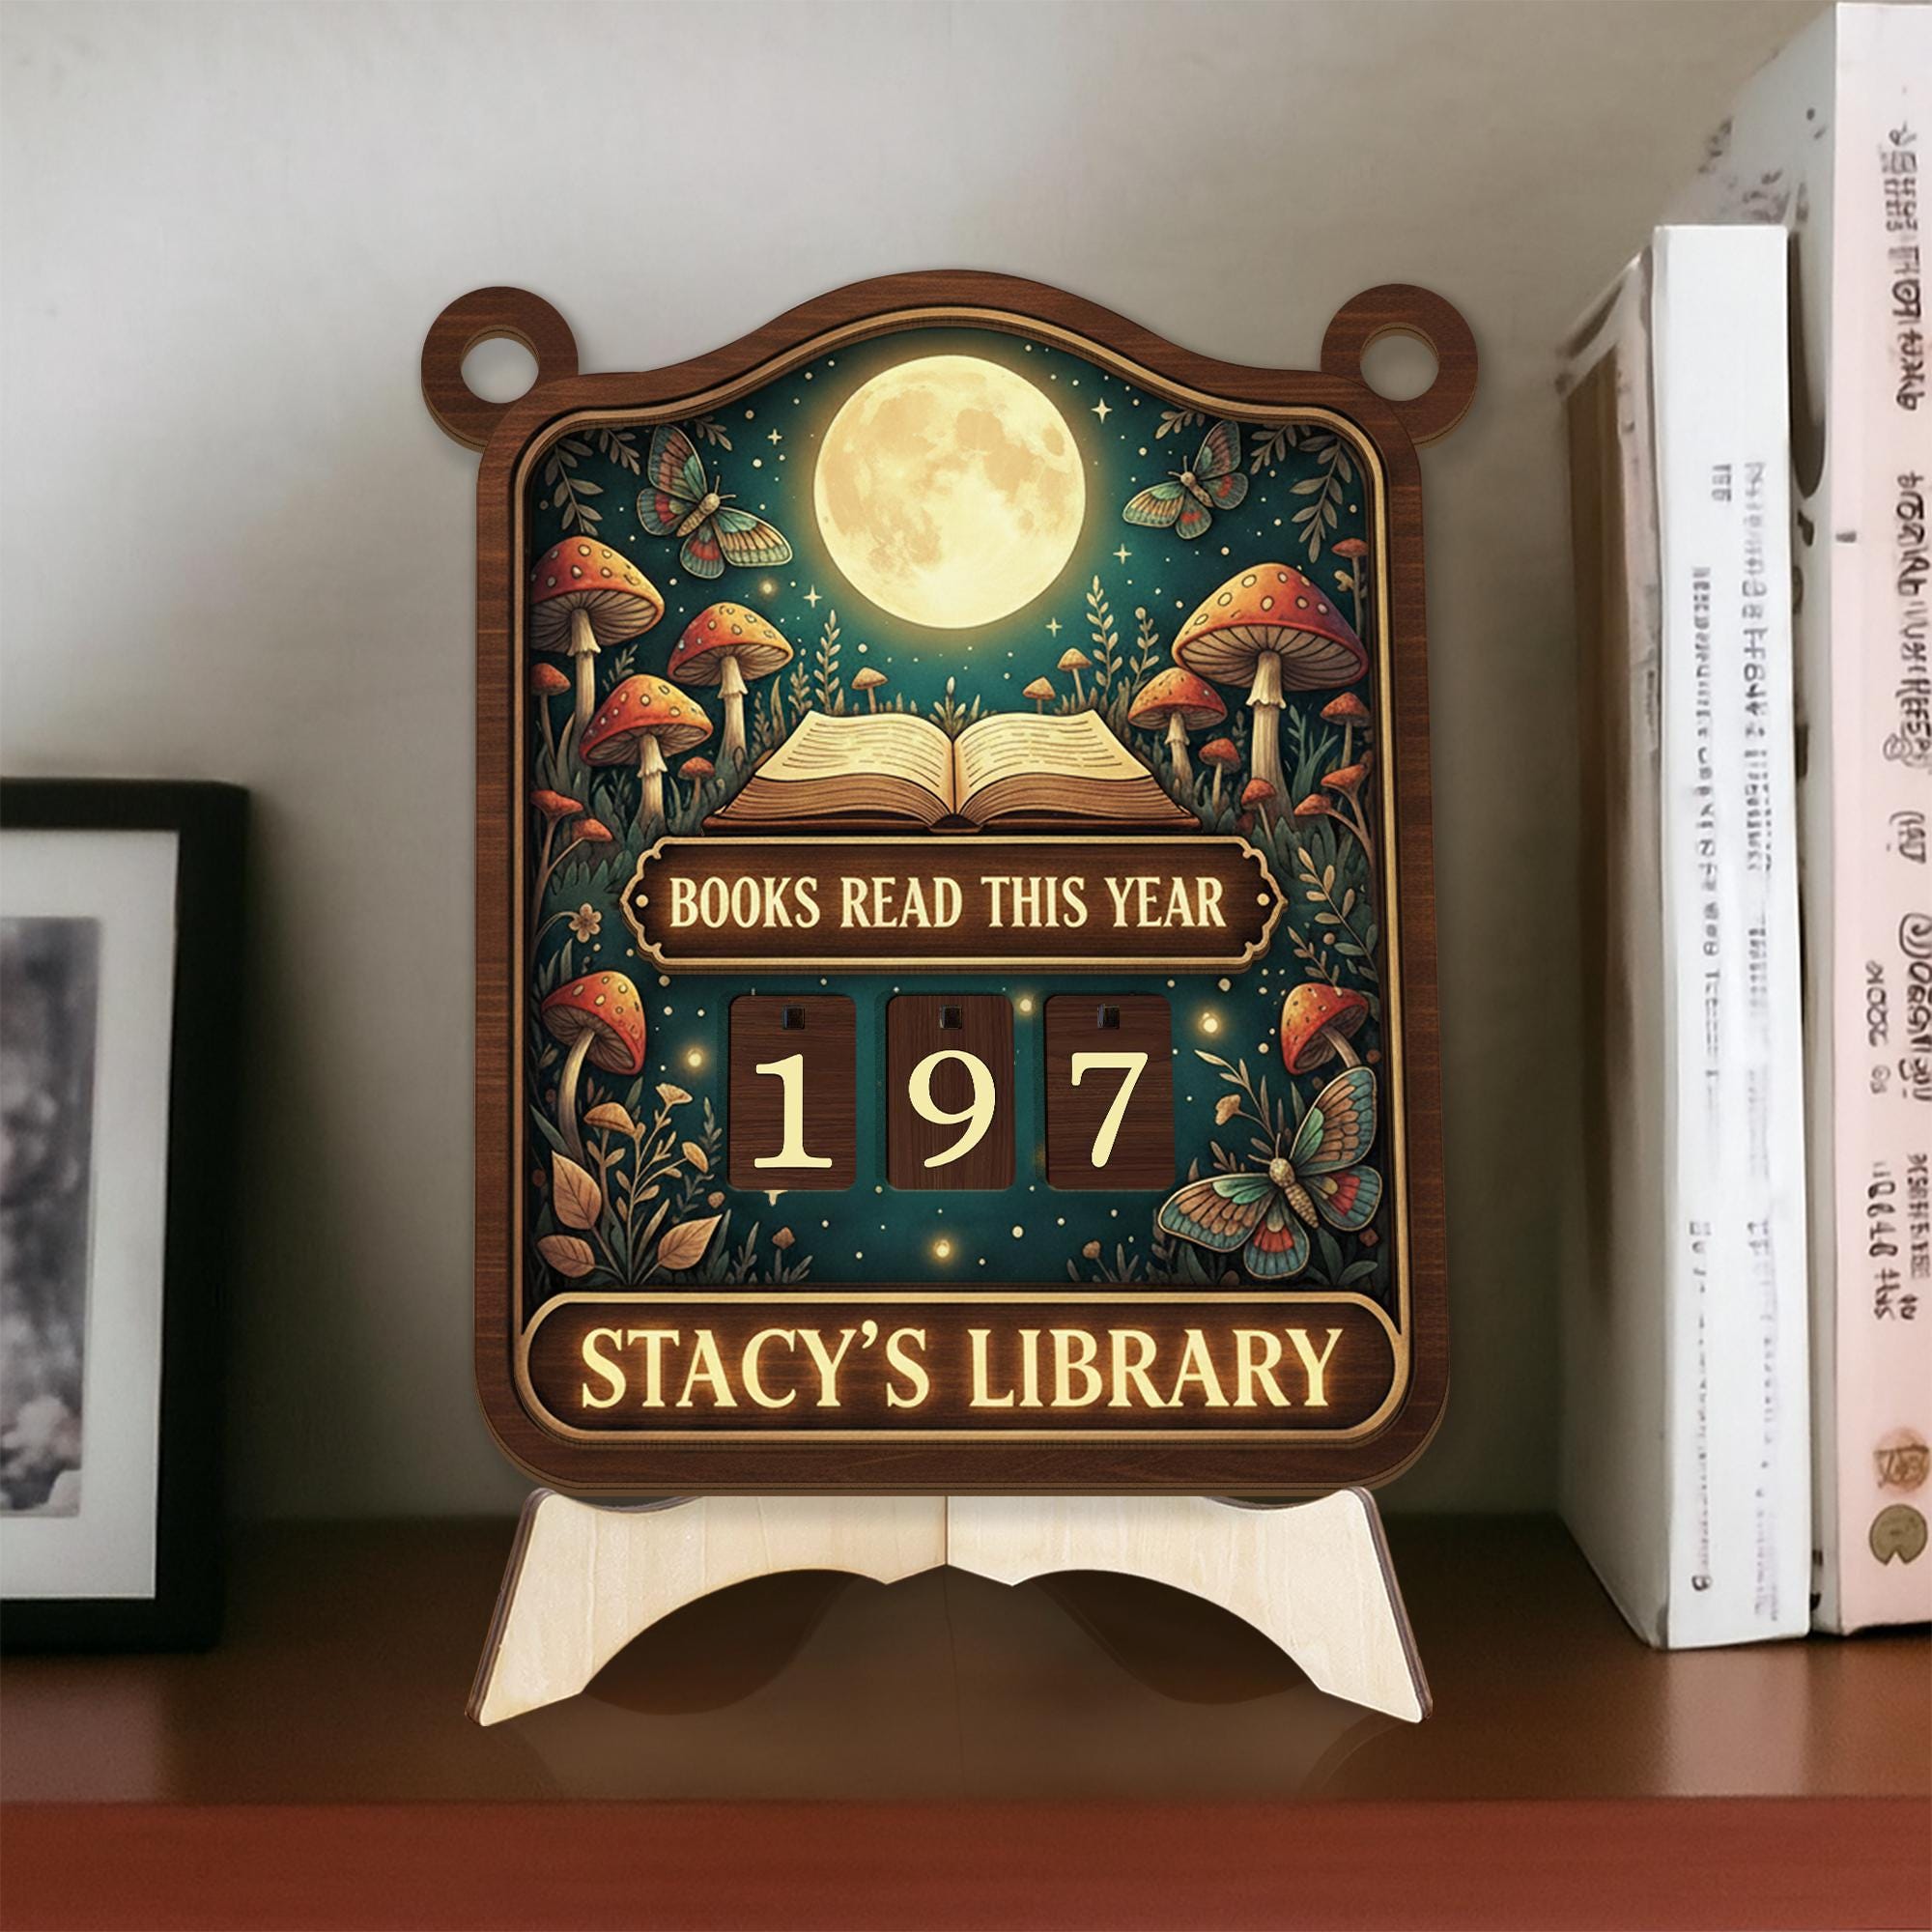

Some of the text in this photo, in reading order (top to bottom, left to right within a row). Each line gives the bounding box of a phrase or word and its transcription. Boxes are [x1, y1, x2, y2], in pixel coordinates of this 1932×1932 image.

[668, 876, 1227, 928] BOOKS READ THIS YEAR
[582, 1320, 1343, 1408] STACY’S LIBRARY
